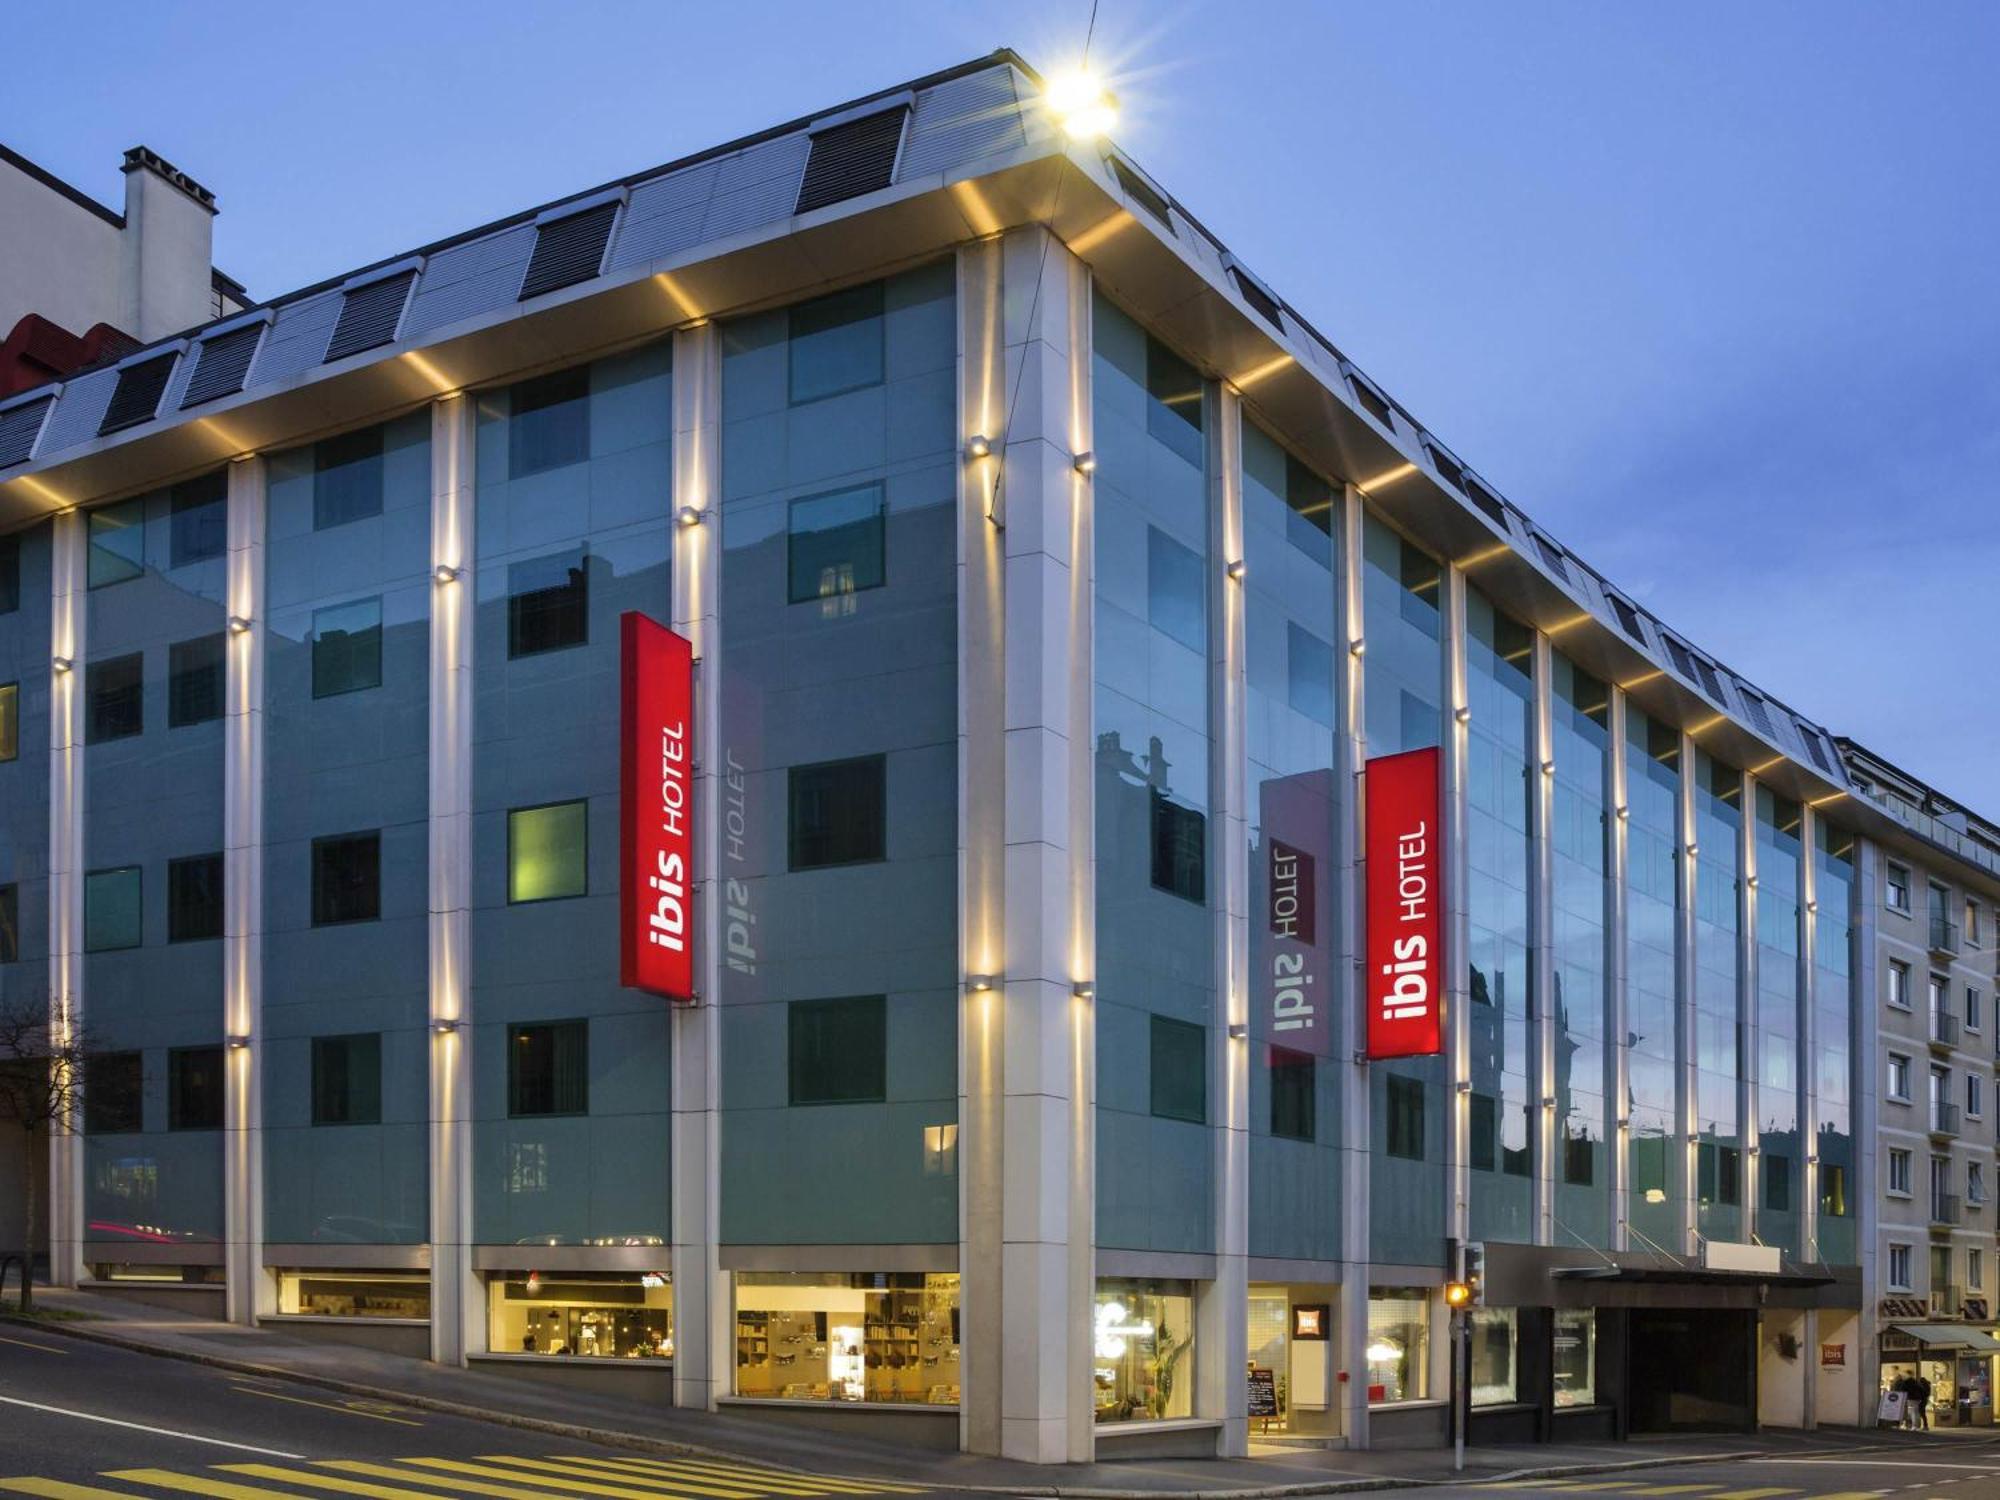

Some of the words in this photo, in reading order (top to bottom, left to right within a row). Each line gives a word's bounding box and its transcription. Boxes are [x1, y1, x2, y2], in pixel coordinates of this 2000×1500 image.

[662, 721, 683, 836] HOTEL
[650, 850, 683, 952] ibis
[1399, 821, 1427, 922] HOTEL
[1383, 934, 1428, 1020] ibis
